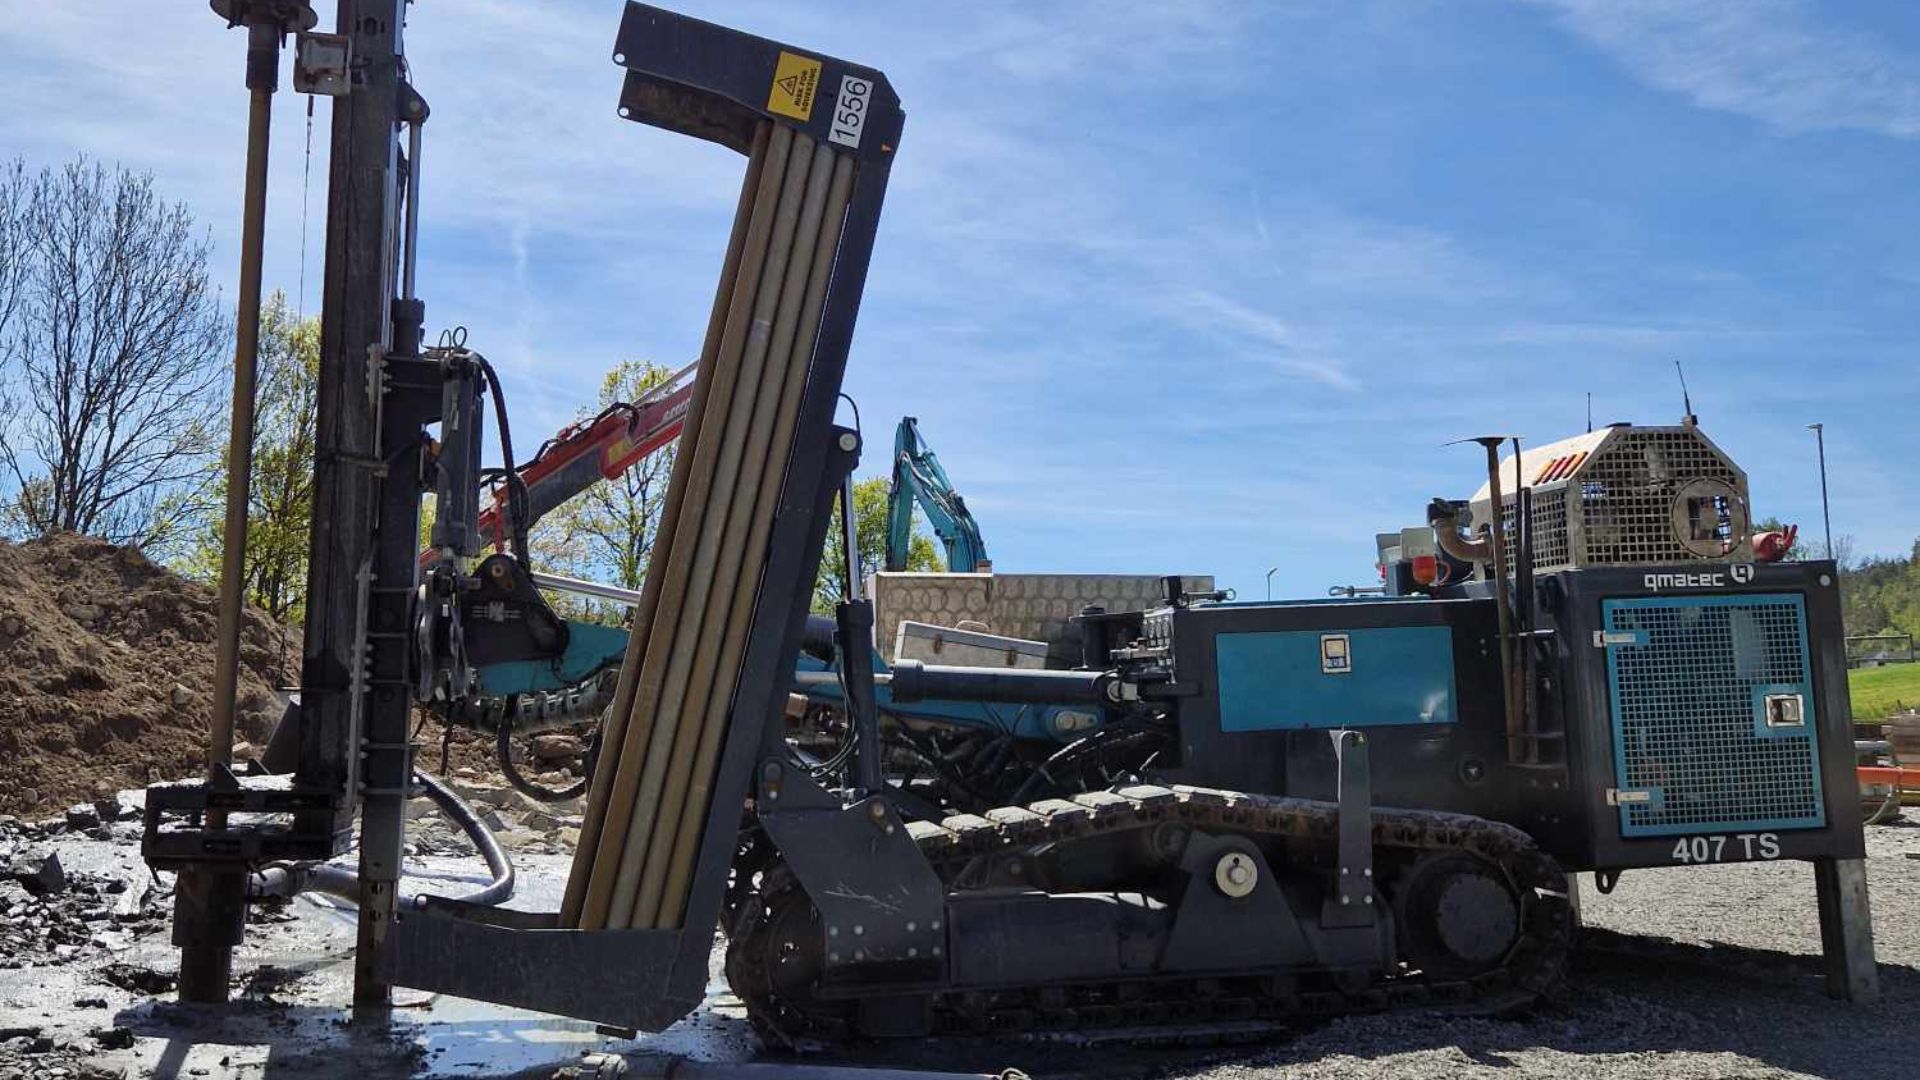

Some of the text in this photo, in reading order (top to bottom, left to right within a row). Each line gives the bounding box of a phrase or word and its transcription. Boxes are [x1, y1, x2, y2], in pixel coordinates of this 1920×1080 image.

[835, 80, 867, 138] 1556
[1644, 573, 1725, 592] qmatec
[1672, 833, 1780, 863] 407 TS
